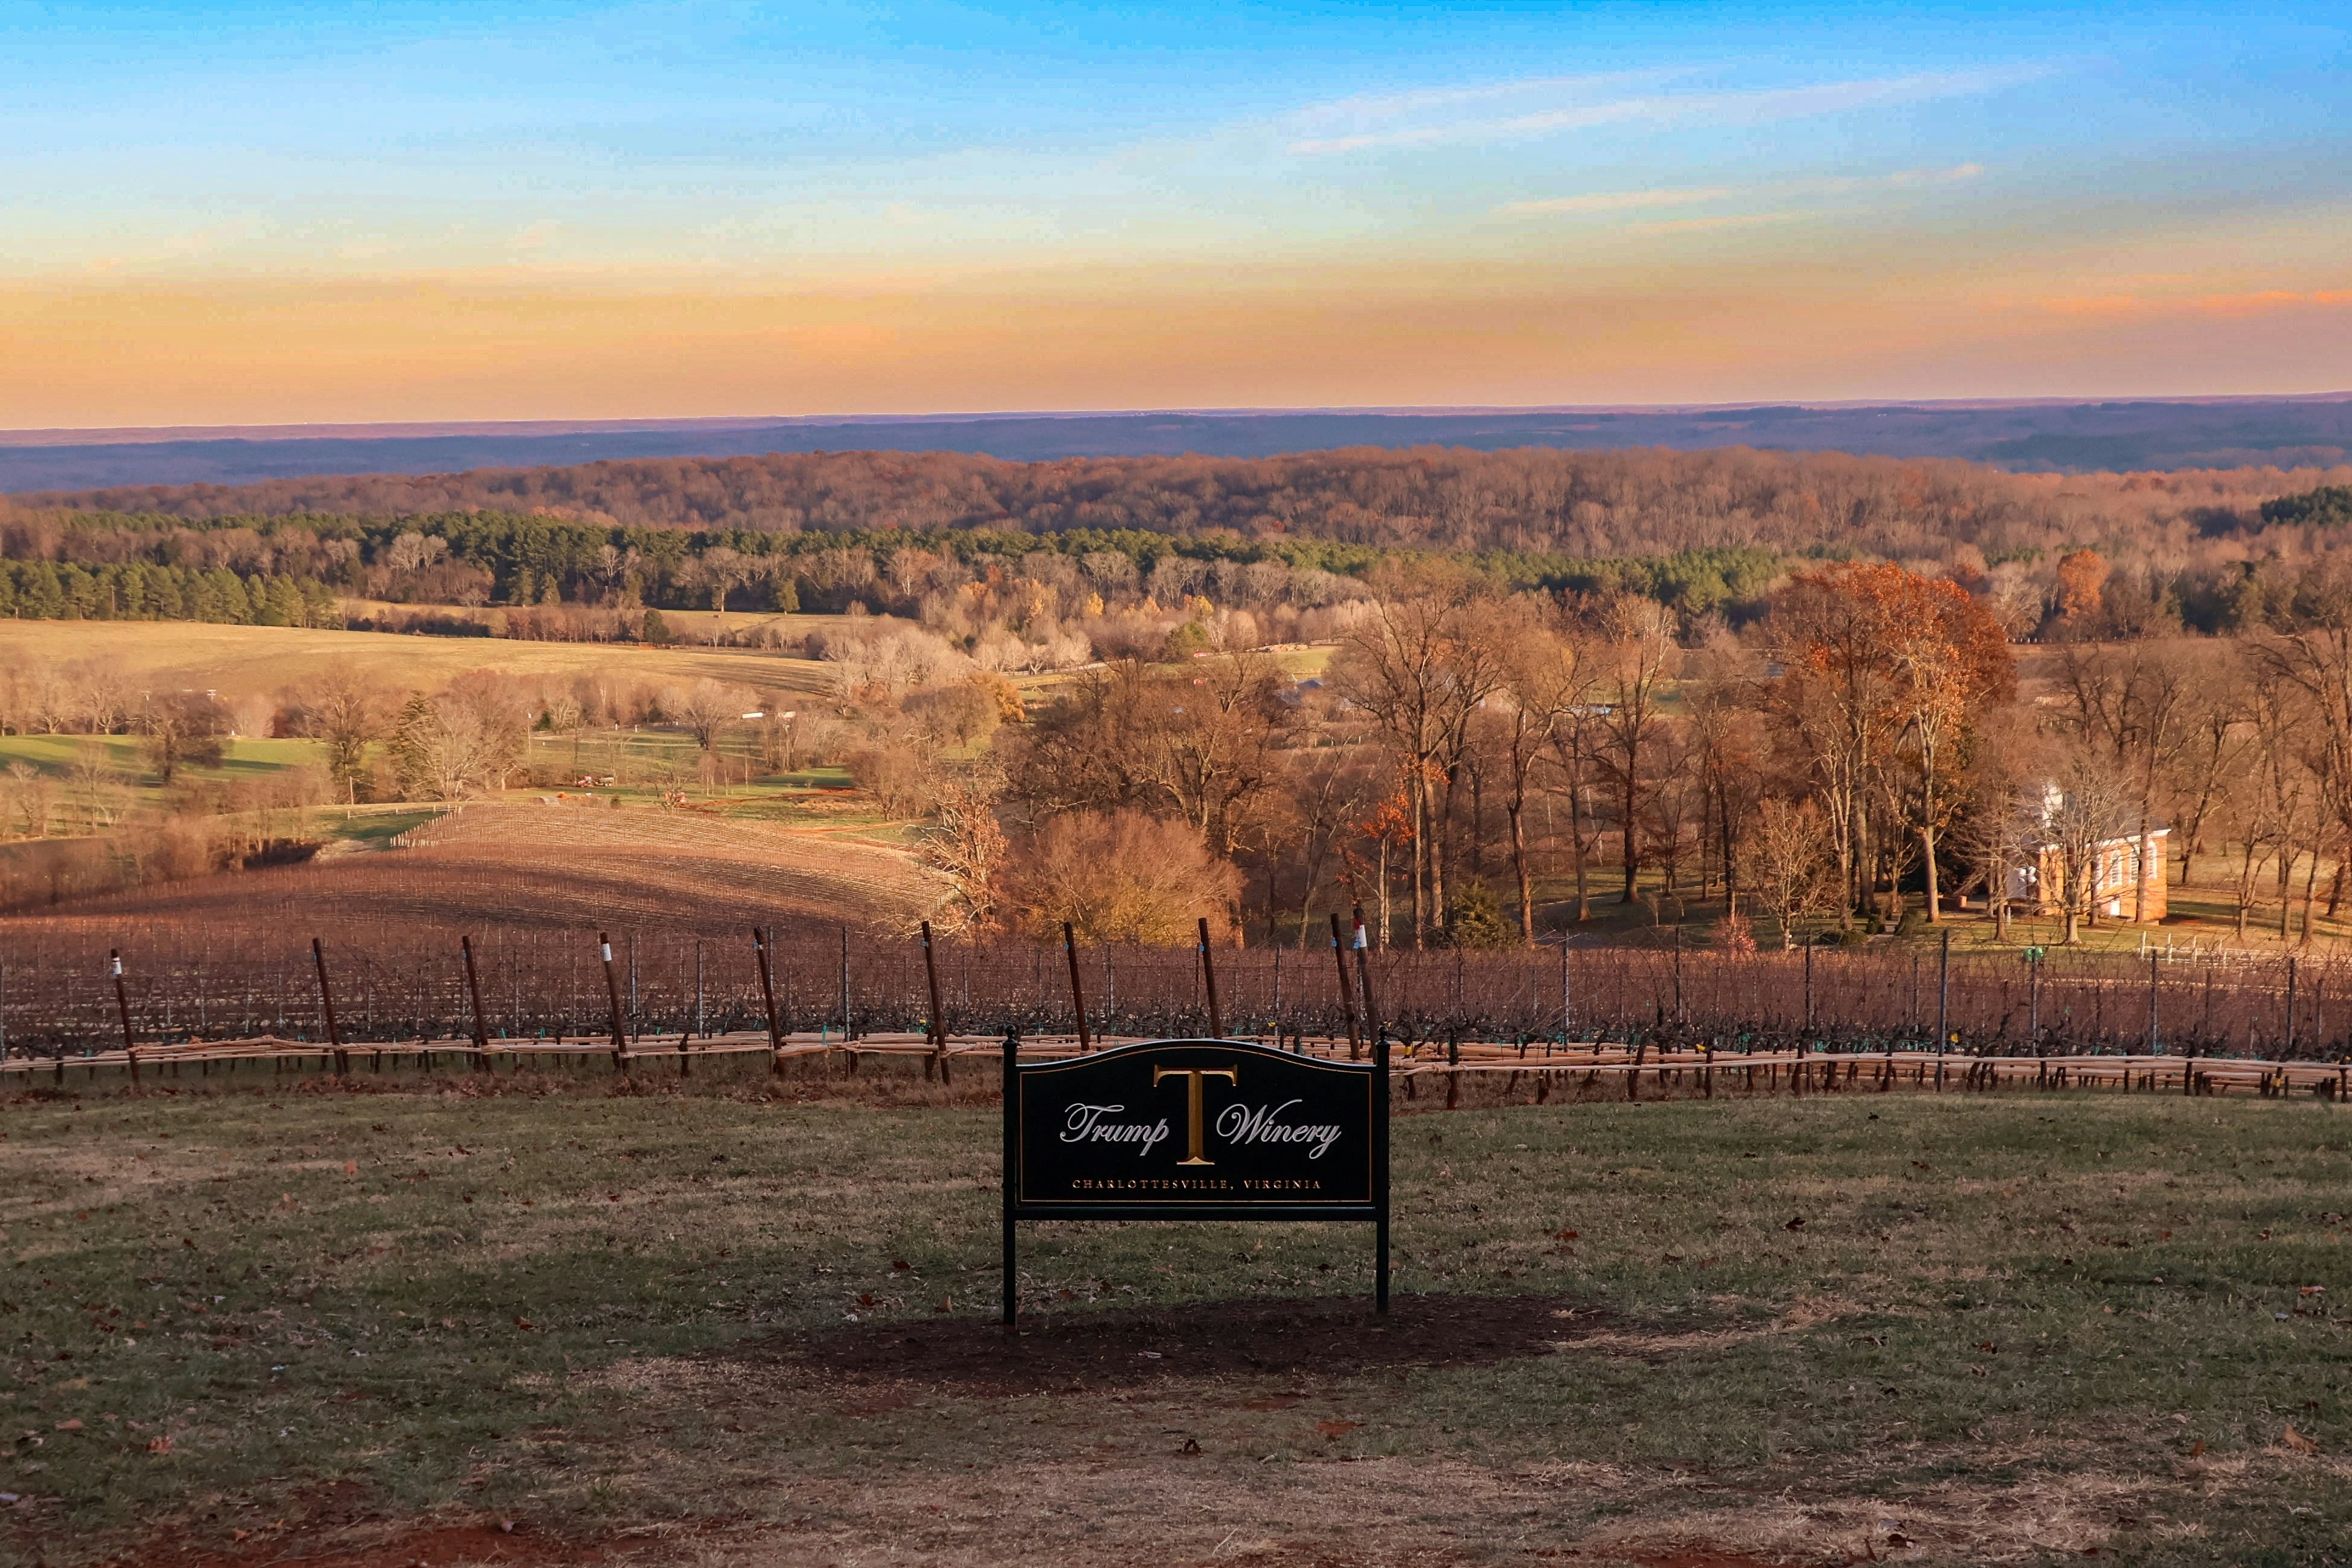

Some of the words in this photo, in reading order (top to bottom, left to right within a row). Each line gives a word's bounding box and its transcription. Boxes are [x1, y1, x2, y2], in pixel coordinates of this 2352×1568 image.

[1060, 1103, 1169, 1156] Trump
[1216, 1099, 1342, 1159] Winery
[1154, 1064, 1237, 1165] T
[1072, 1180, 1234, 1191] CHARLOTTESVILLE,
[1244, 1180, 1322, 1189] VIRGINIA
